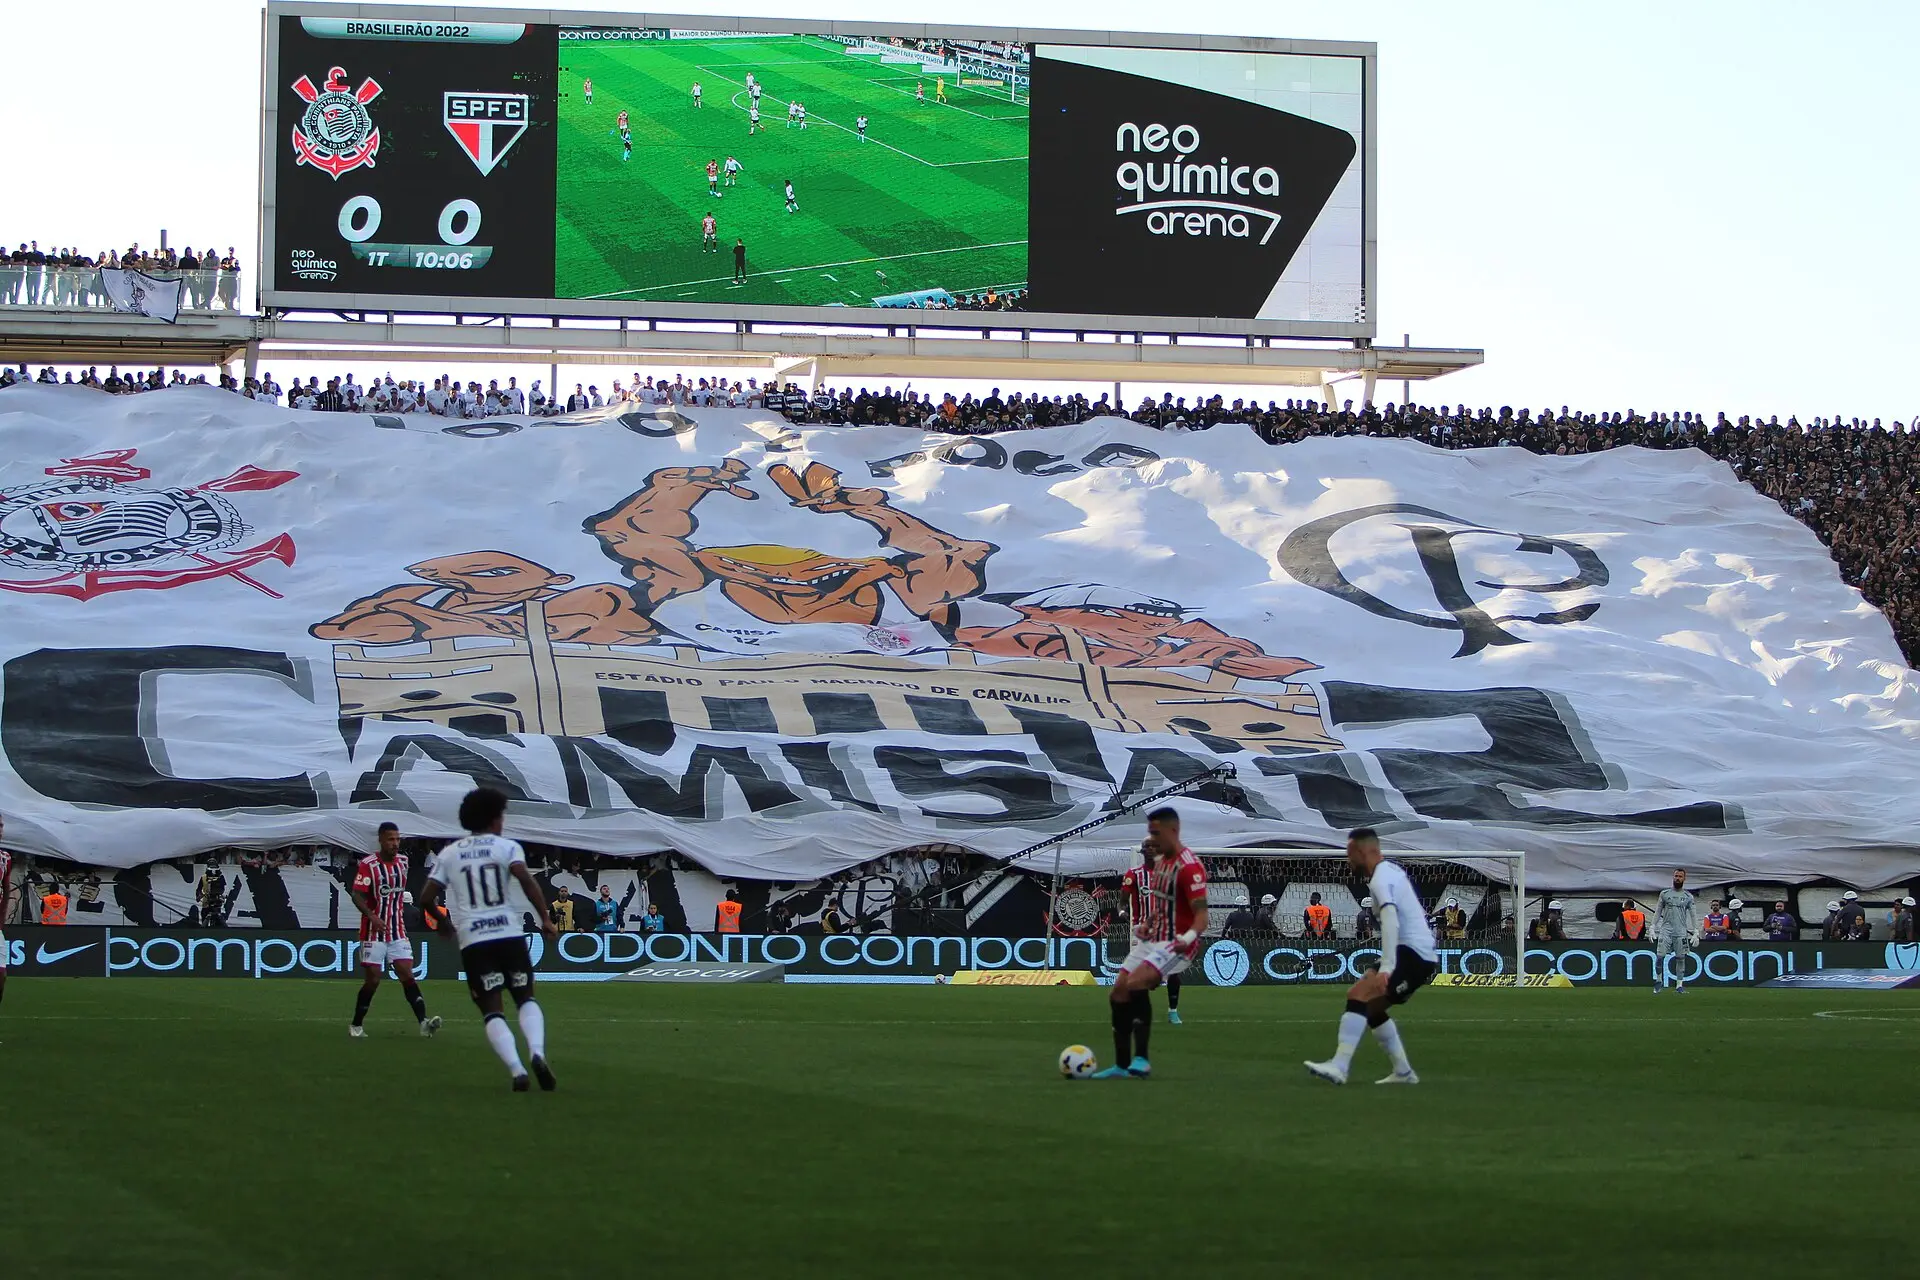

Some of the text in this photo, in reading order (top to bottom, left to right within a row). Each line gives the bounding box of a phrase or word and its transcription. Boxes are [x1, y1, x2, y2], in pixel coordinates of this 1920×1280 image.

[346, 22, 470, 38] BRASILEIRÃO 2022
[602, 31, 665, 40] company
[452, 99, 521, 118] SPFC
[312, 97, 363, 141] CORINTHIANS PAULISTA
[328, 141, 347, 149] 1910
[1116, 122, 1200, 154] neo
[1116, 155, 1280, 202] química
[338, 195, 481, 246] 0 0
[1146, 211, 1249, 238] arena
[291, 249, 315, 258] neo
[367, 251, 474, 270] 1T 10:06
[291, 257, 337, 270] química
[299, 271, 329, 280] arena
[55, 550, 132, 564] 1910
[694, 623, 781, 636] CAMISA
[594, 671, 703, 687] ESTÁDIO
[930, 685, 959, 697] DE
[460, 862, 505, 909] 10
[557, 932, 806, 966] ODONTO
[1263, 946, 1504, 980] ODOTO
[626, 967, 761, 979] OGOCHI
